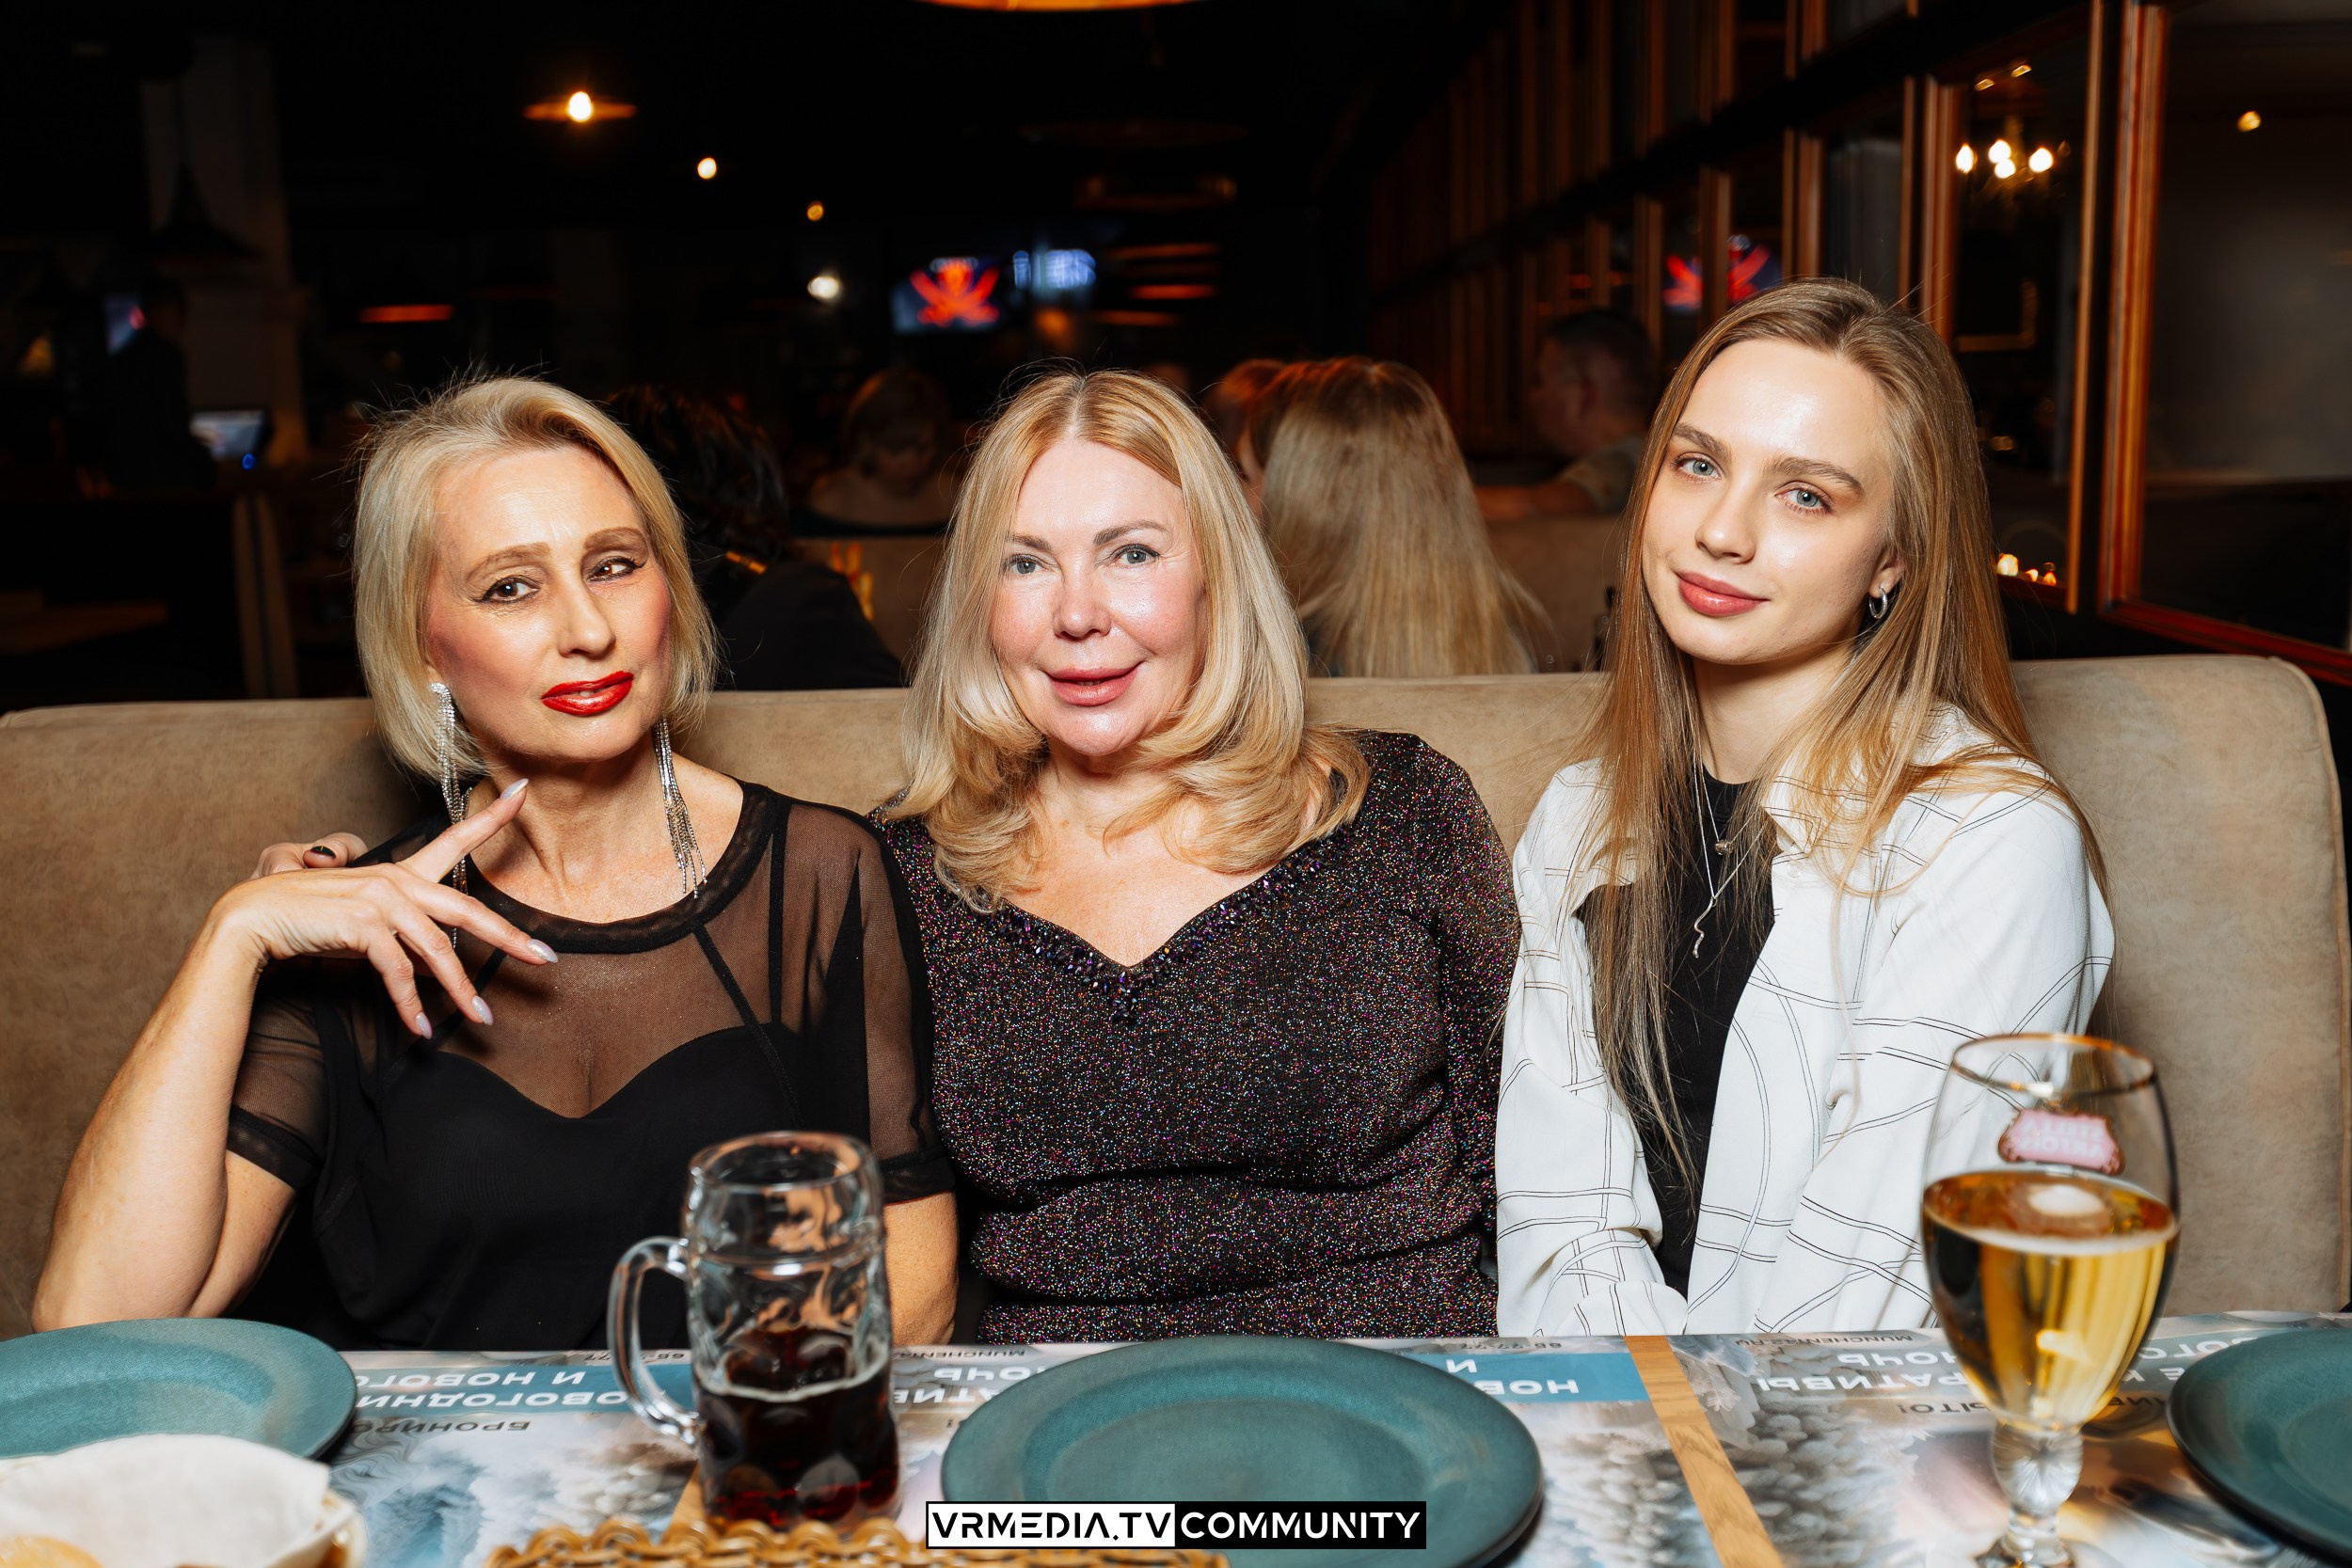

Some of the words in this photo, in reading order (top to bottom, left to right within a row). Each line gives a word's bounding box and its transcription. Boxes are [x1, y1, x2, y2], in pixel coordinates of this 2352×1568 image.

[551, 1370, 586, 1385] И
[933, 1366, 1046, 1382] ОЧЬ
[356, 1391, 632, 1409] ОВОГОДНИ
